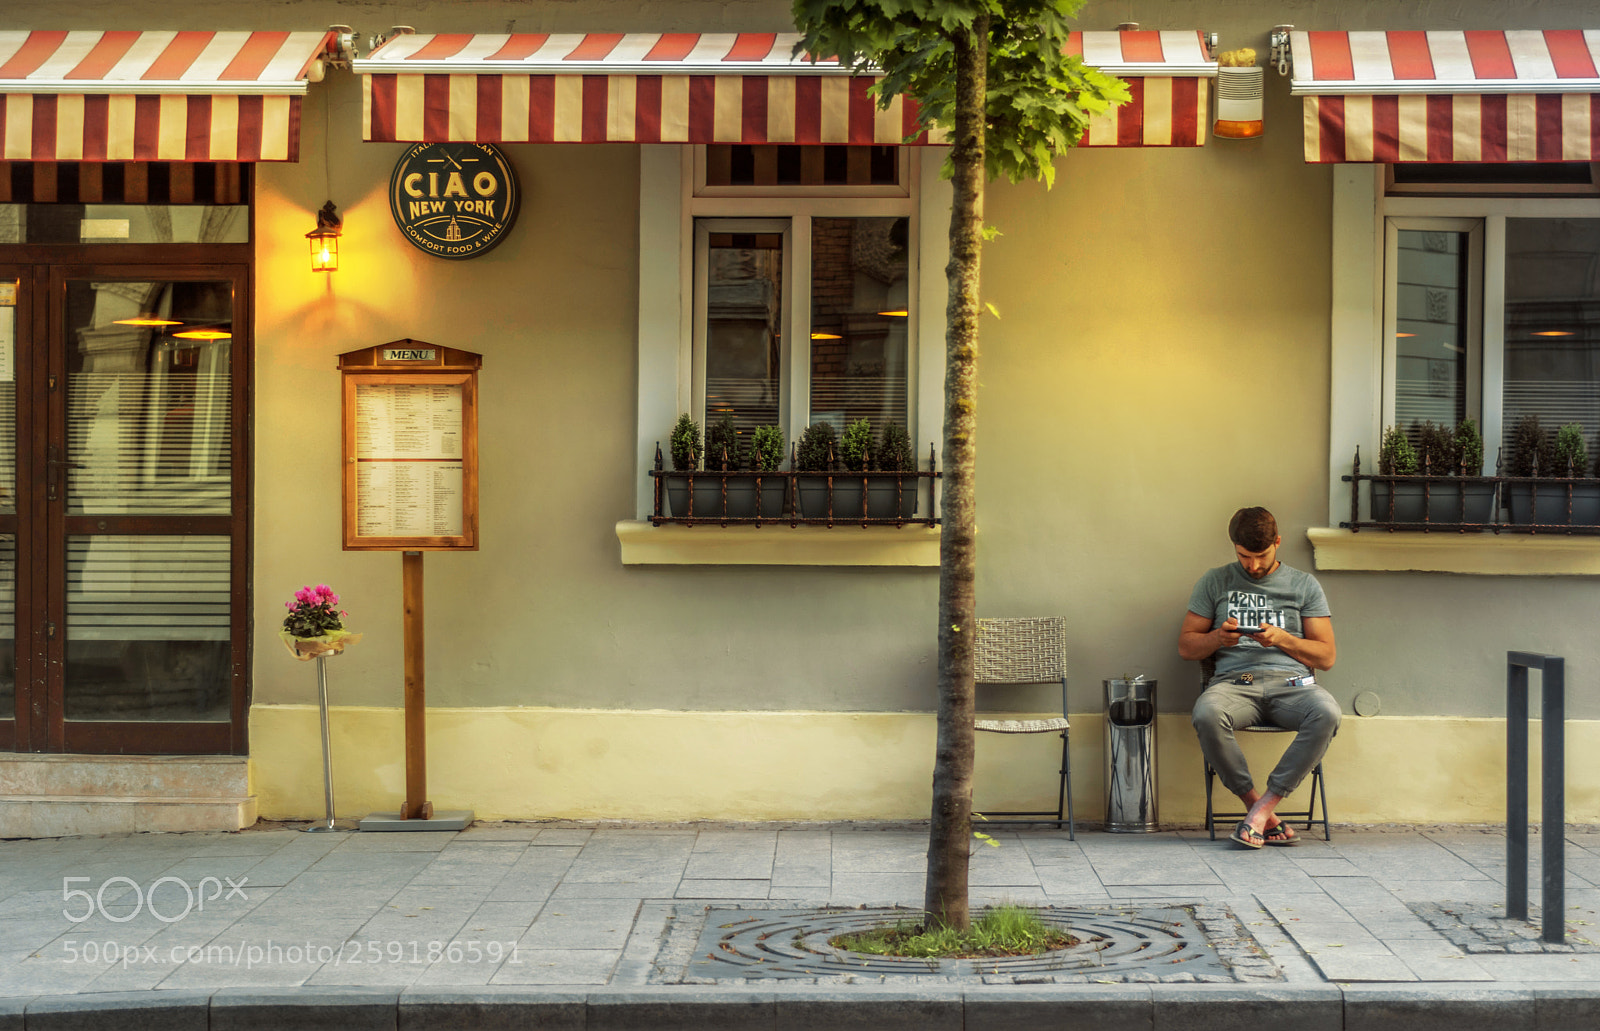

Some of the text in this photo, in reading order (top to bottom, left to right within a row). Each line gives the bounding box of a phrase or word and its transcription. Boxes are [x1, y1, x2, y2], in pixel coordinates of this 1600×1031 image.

[404, 171, 498, 198] CIAO
[409, 200, 495, 220] NEW YORK
[406, 222, 503, 254] COMFORT FOOD & WINE
[390, 350, 429, 360] MENU
[1229, 592, 1265, 607] 42ND
